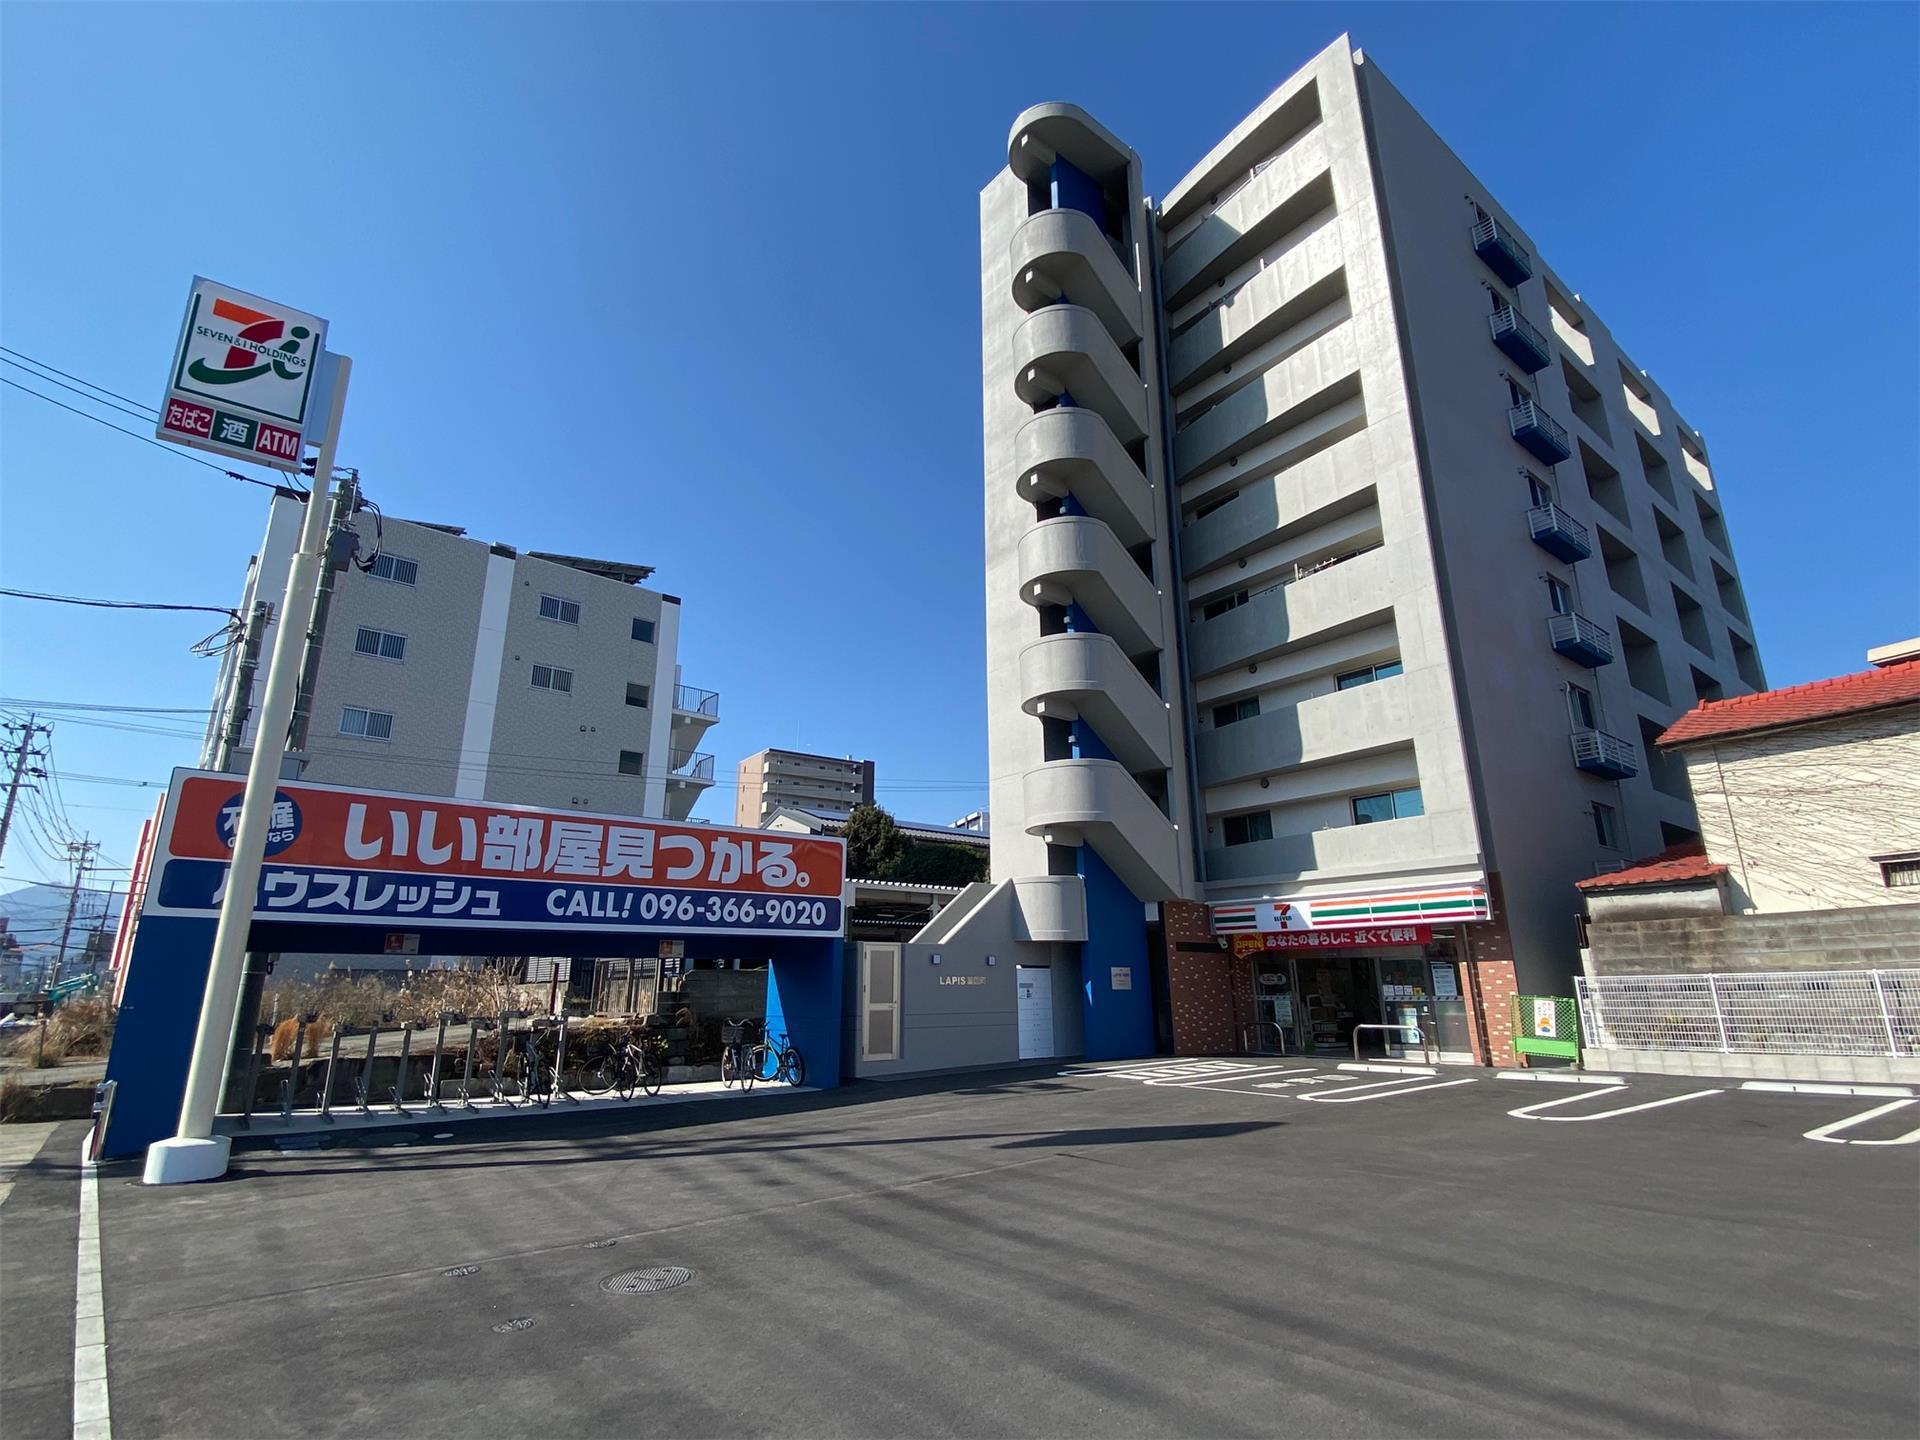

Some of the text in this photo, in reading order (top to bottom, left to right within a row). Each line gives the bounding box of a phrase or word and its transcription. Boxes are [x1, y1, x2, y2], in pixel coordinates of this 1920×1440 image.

[249, 342, 307, 368] HOLDINGS
[167, 404, 211, 433] たばこ
[219, 417, 250, 443] 酒
[258, 429, 298, 457] ATM
[222, 800, 295, 832] 不産
[227, 829, 295, 848] のなら
[344, 802, 811, 889] いい部屋見つかる。
[546, 888, 827, 926] CALL! 096-366-9020
[1266, 927, 1417, 948] あなたの暮らしに 近くて便利
[939, 975, 967, 986] LAPIS
